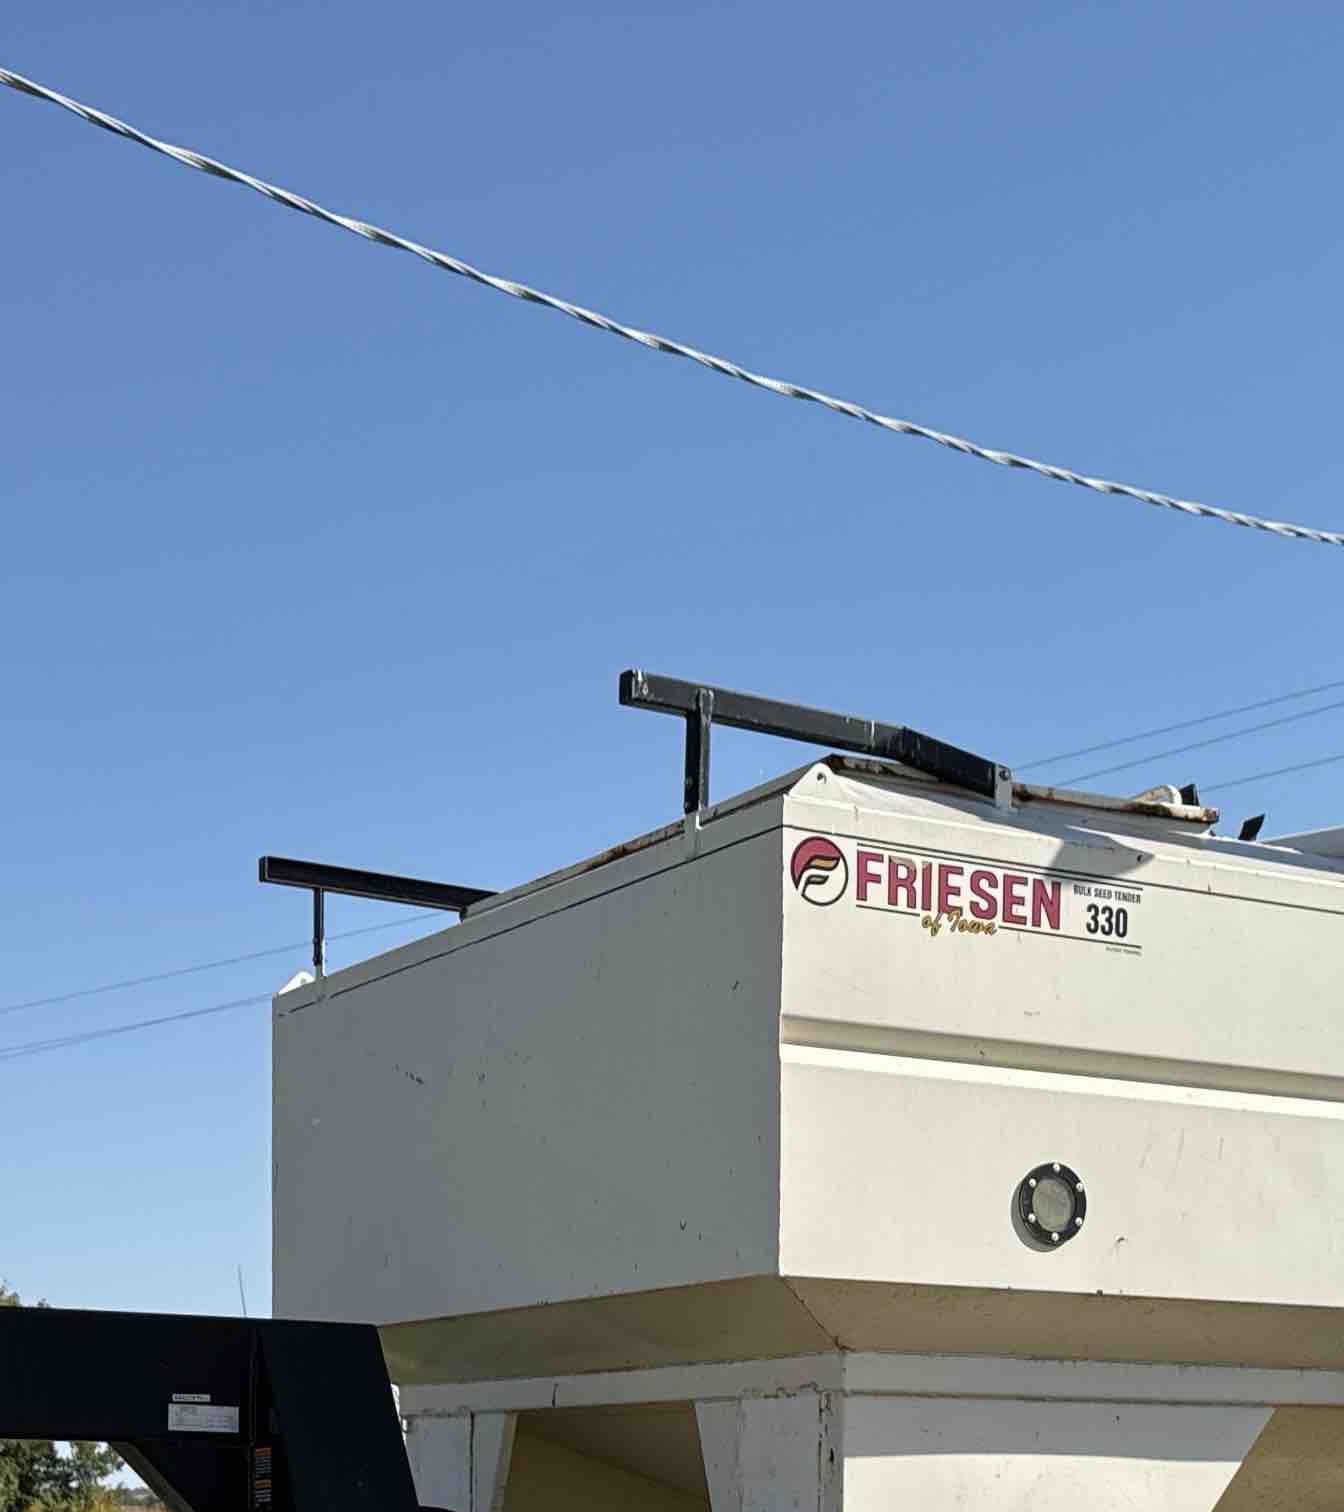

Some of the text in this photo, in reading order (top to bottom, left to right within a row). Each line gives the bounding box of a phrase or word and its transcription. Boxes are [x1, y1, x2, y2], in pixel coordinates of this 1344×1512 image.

[856, 850, 1061, 930] FRIESEN
[1094, 887, 1113, 900] SEED
[1115, 891, 1142, 905] TENDER
[921, 911, 944, 937] of
[1086, 903, 1128, 938] 330
